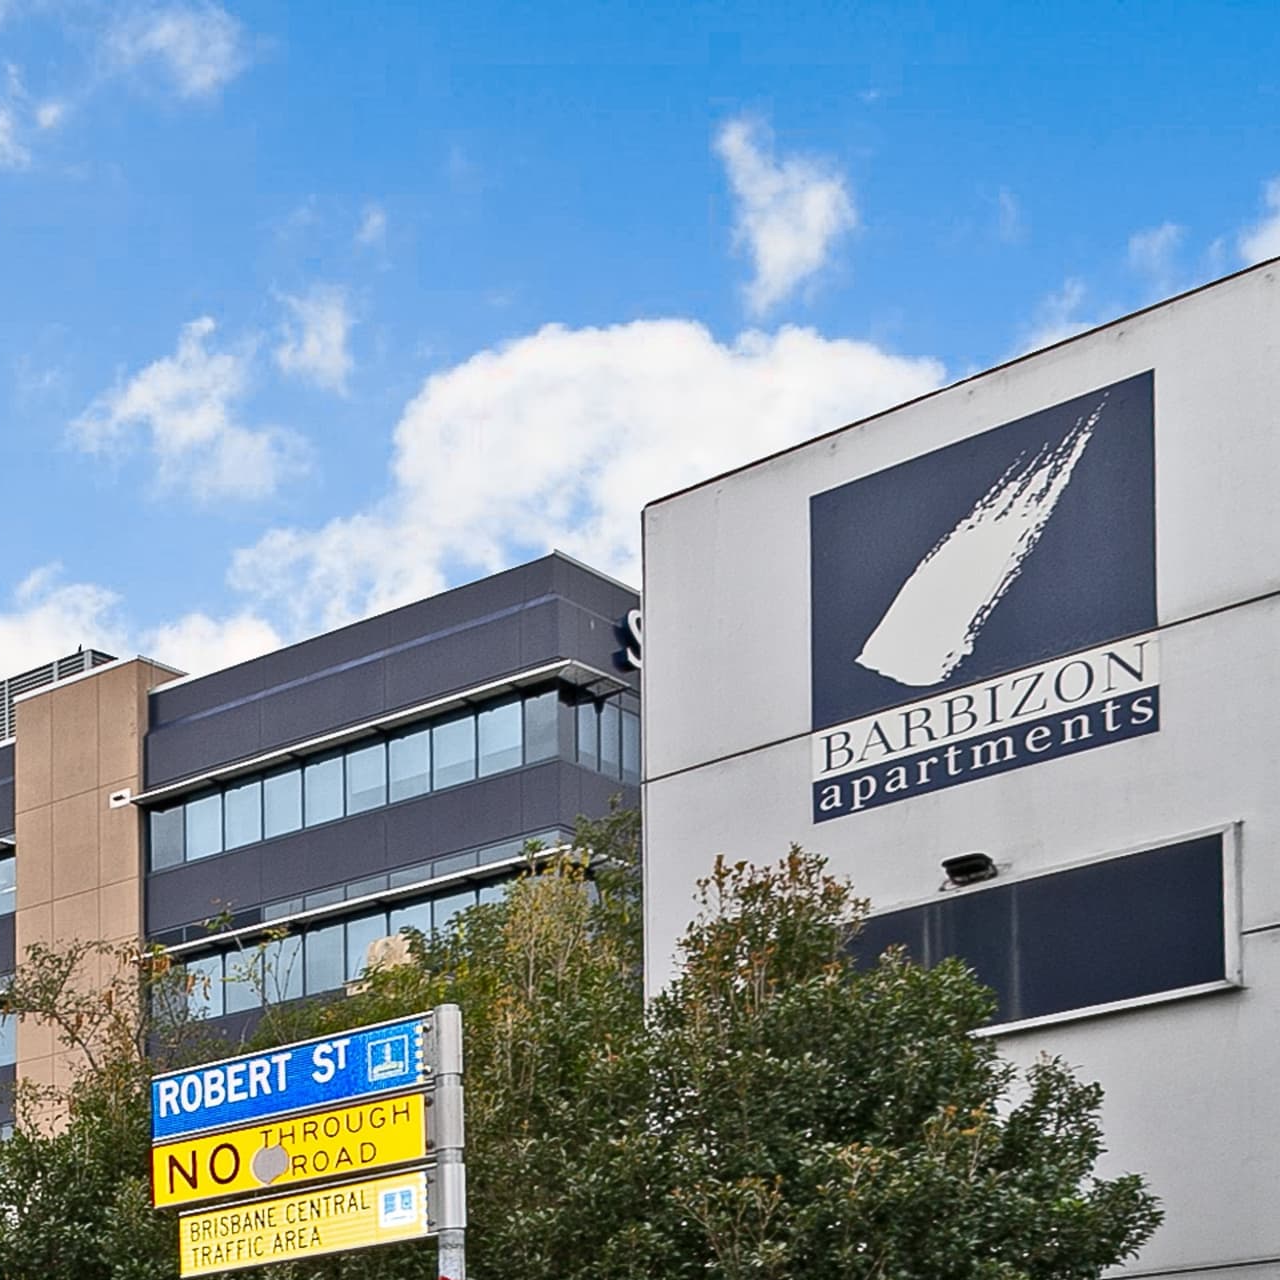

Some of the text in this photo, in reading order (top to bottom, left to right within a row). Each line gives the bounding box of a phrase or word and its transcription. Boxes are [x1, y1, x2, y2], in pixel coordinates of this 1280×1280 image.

[821, 640, 1151, 773] BARBIZON
[819, 695, 1154, 810] apartments
[159, 1038, 351, 1118] ROBERT ST
[260, 1101, 410, 1148] THROUGH
[168, 1142, 240, 1194] NO
[291, 1142, 377, 1176] ROAD
[190, 1189, 370, 1242] BRISBANE CENTRAL
[192, 1226, 322, 1267] TRAFFIC AREA
